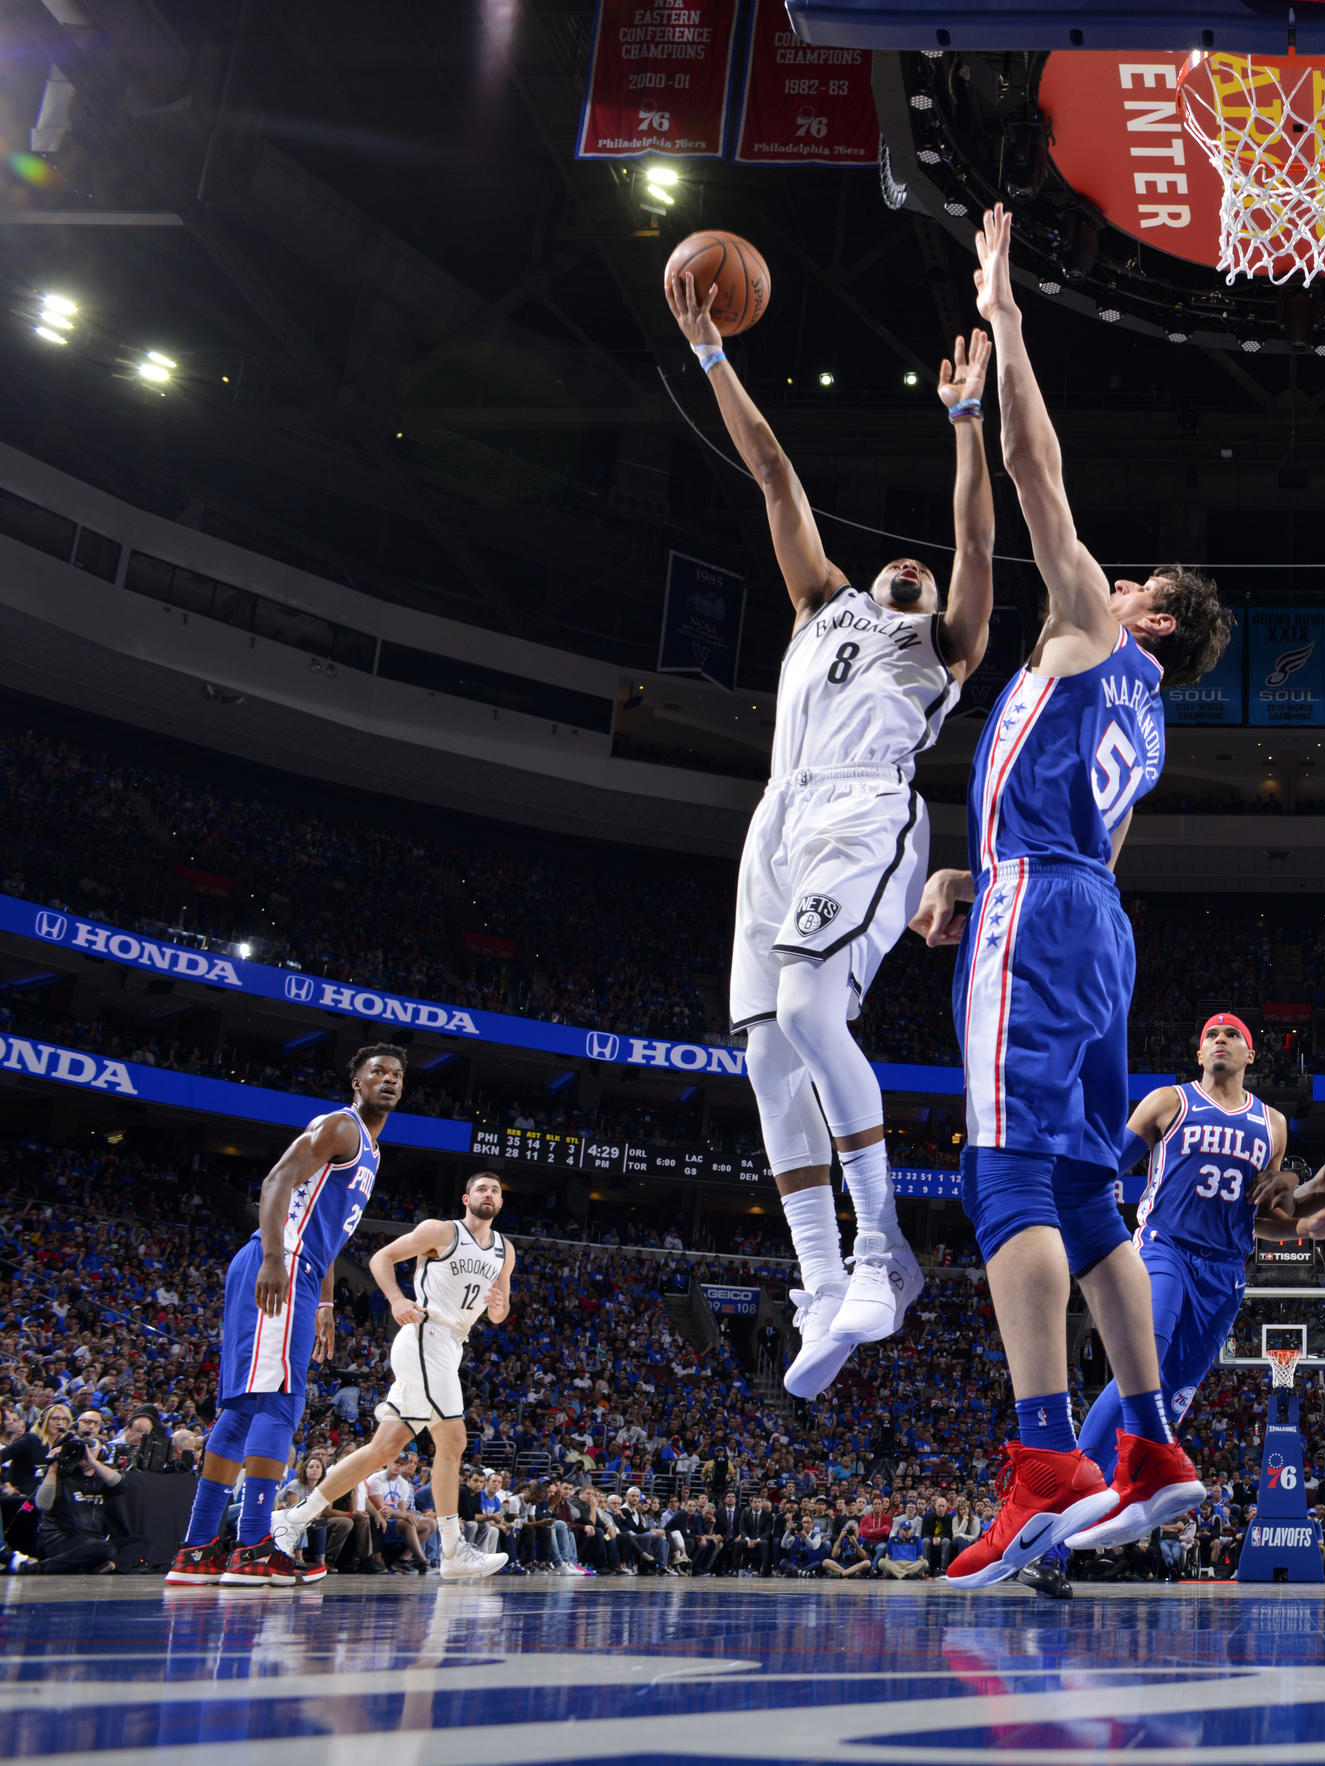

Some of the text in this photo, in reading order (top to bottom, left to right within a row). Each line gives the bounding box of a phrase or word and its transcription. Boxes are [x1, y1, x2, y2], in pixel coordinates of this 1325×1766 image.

[633, 10, 702, 25] EASTERN
[619, 27, 713, 42] CONFERENCE
[621, 43, 706, 60] CHAMPIONS
[776, 48, 863, 65] CHAMPIONS
[628, 73, 691, 90] 2000-01
[784, 80, 849, 95] 1982-83
[638, 111, 671, 132] 76
[795, 116, 828, 139] 76
[598, 138, 707, 149] Philadelphia 76ers
[754, 143, 865, 156] Philadelphia 76ers
[1119, 63, 1191, 229] ENTER
[827, 641, 861, 684] 8
[1169, 690, 1231, 701] SOUL
[1259, 690, 1320, 702] SOUL
[1091, 720, 1144, 832] 51
[798, 895, 838, 926] NETS
[72, 922, 242, 986] HONDA
[319, 983, 480, 1035] HONDA
[627, 1041, 747, 1075] HON
[477, 1131, 498, 1144] PHI
[526, 1131, 541, 1139] AST
[565, 1136, 579, 1144] STL
[473, 1143, 499, 1156] BKN
[507, 1136, 575, 1154] 35 14 7 3
[588, 1145, 620, 1159] 4:29
[1181, 1125, 1267, 1172] PHILA
[505, 1148, 574, 1166] 28 11 2 4
[629, 1149, 647, 1158] ORL
[685, 1154, 703, 1163] LAC
[595, 1159, 610, 1168] PM
[628, 1161, 647, 1171] TOR
[712, 1163, 732, 1172] 8:00
[741, 1159, 754, 1168] SA
[684, 1167, 697, 1176] GS
[739, 1172, 759, 1181] DEN
[906, 1172, 917, 1180] 33
[921, 1173, 932, 1181] 51
[1196, 1164, 1243, 1202] 33
[952, 1187, 959, 1195] 4
[1274, 1252, 1311, 1261] TISSOT
[460, 1282, 481, 1310] 12
[707, 1289, 752, 1300] GEICO
[737, 1303, 757, 1313] 108
[1268, 1425, 1297, 1433] SPALDING
[1267, 1465, 1297, 1490] 76
[1261, 1527, 1312, 1547] PLAYOFFS
